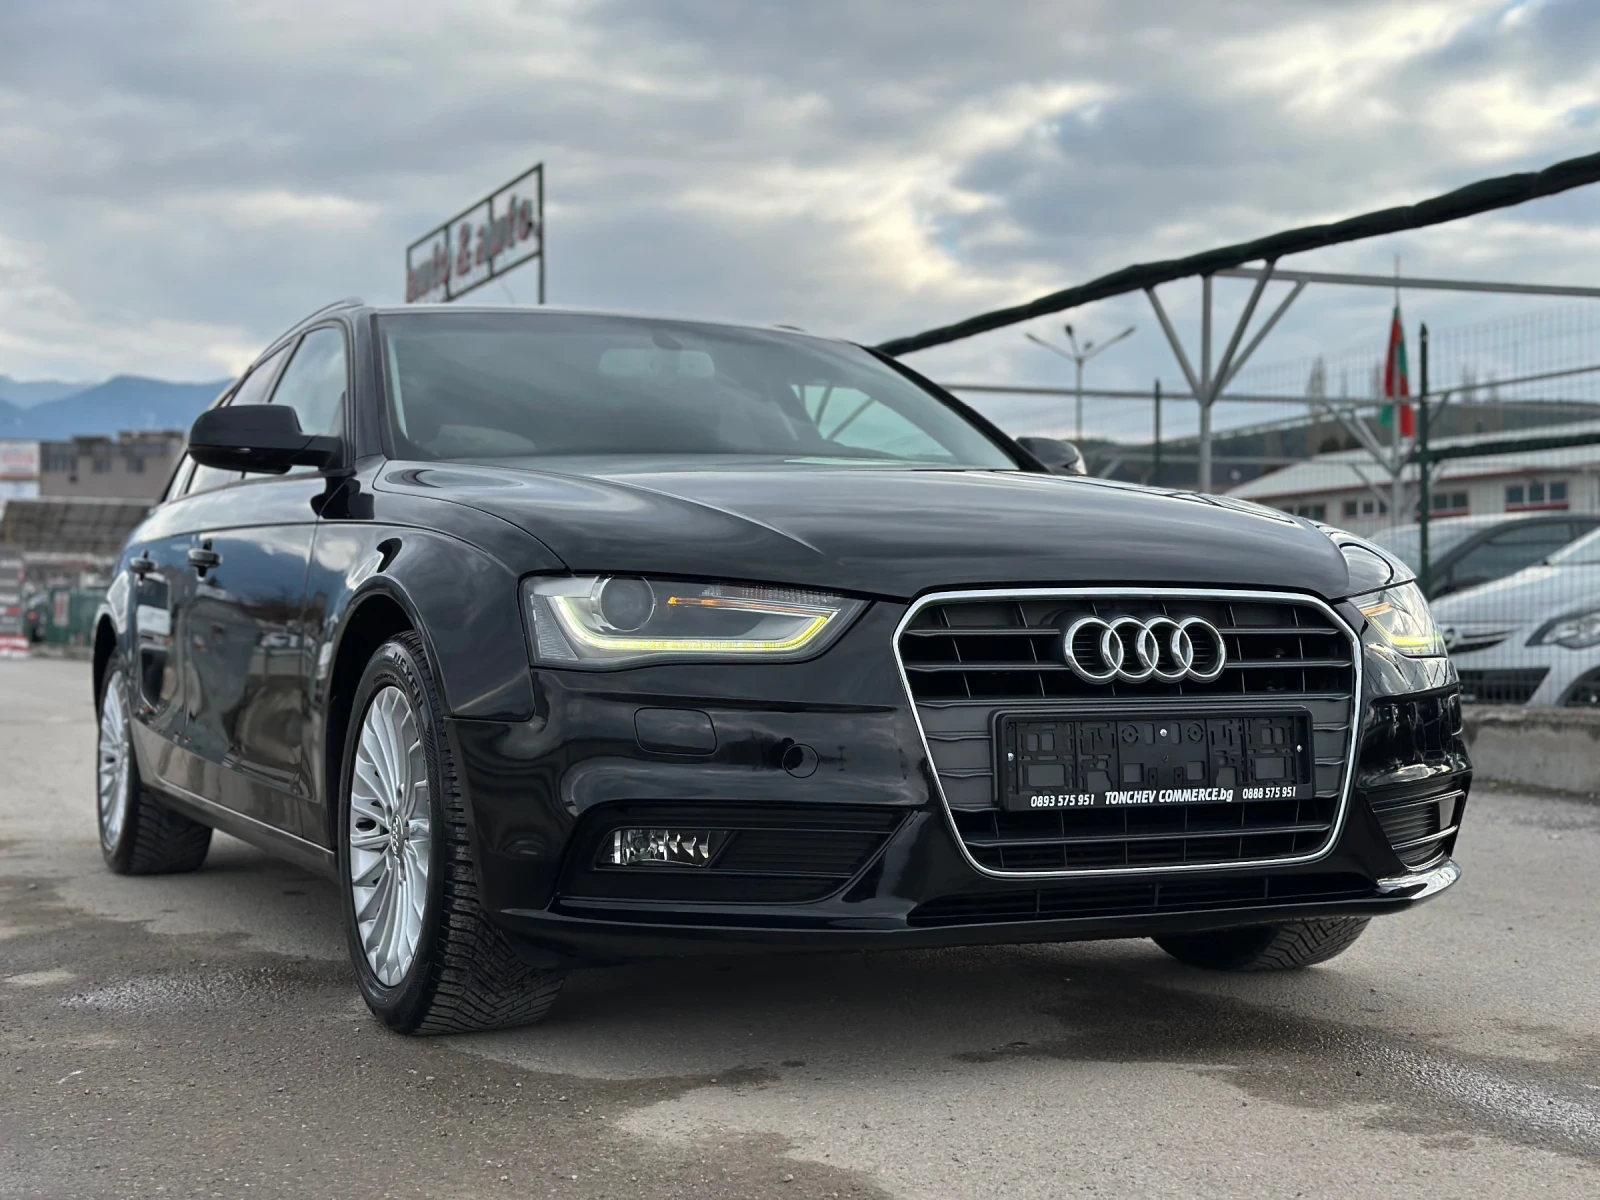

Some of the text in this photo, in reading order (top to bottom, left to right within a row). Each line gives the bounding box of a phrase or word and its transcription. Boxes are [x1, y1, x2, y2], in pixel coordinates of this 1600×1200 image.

[393, 651, 424, 709] NEXEN
[1030, 793, 1095, 807] 0893 575 951
[1104, 787, 1234, 805] TONCHEV COMMERCE.bg
[1242, 786, 1297, 799] 0888 575 951
